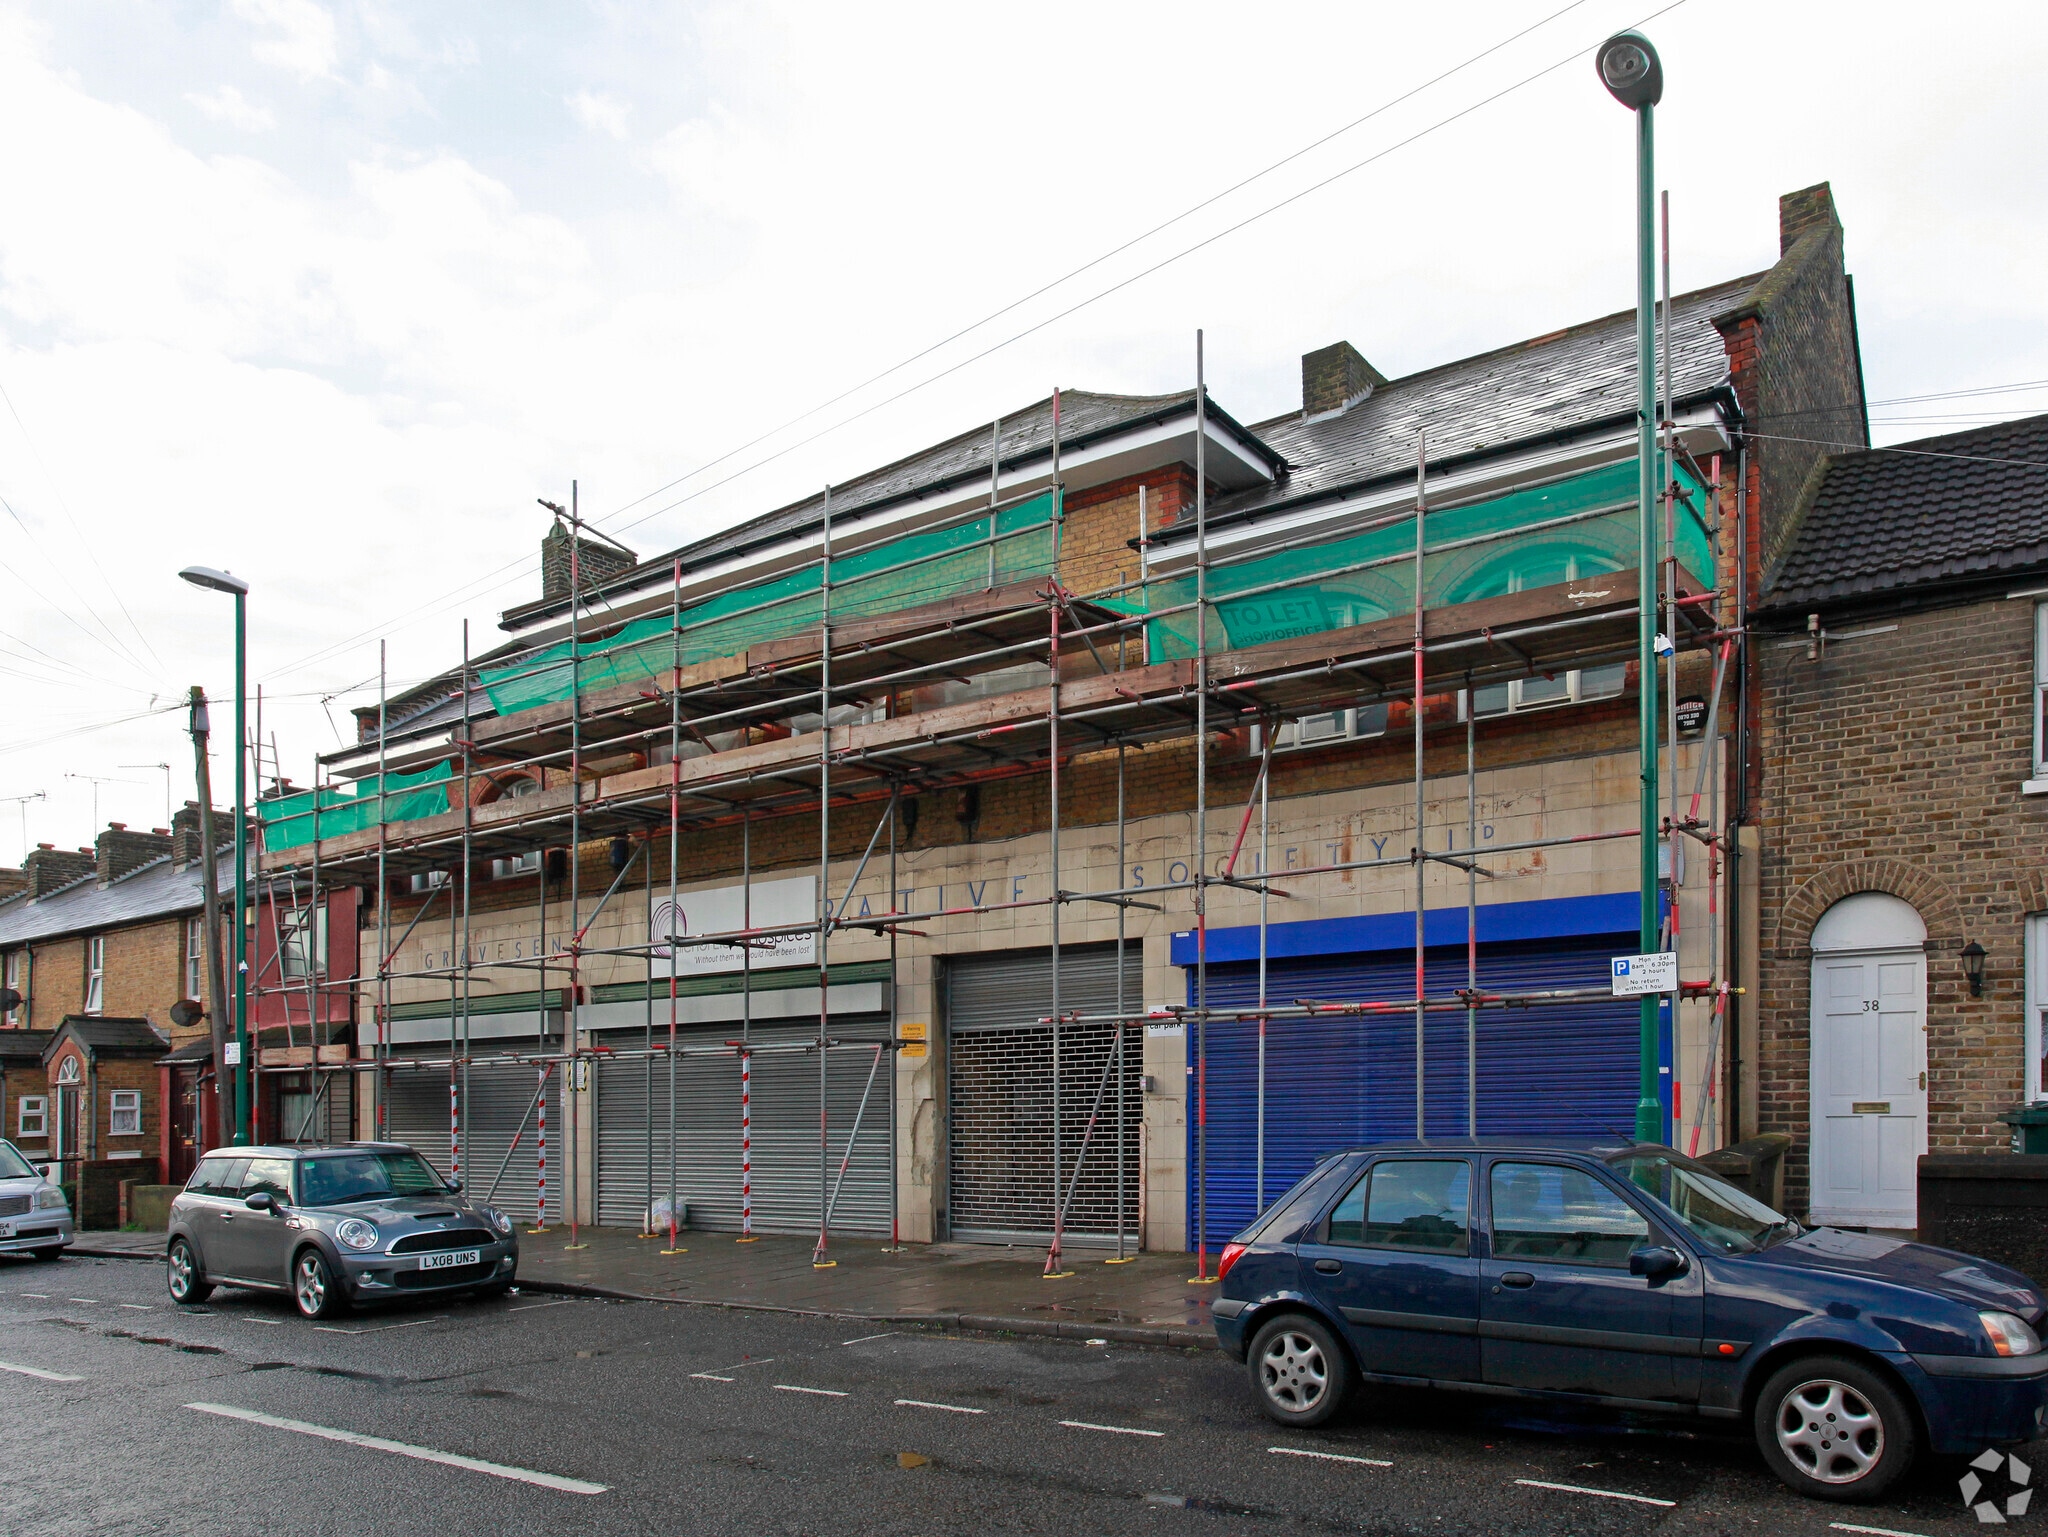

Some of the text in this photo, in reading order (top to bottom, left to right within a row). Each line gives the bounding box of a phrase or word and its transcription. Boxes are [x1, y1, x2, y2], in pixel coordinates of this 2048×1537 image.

[1222, 600, 1314, 626] TO LET
[425, 936, 583, 969] GRAVESEN
[719, 954, 735, 962] them
[781, 947, 797, 956] been
[1862, 999, 1879, 1012] 38
[424, 1252, 476, 1268] LX08 UNS
